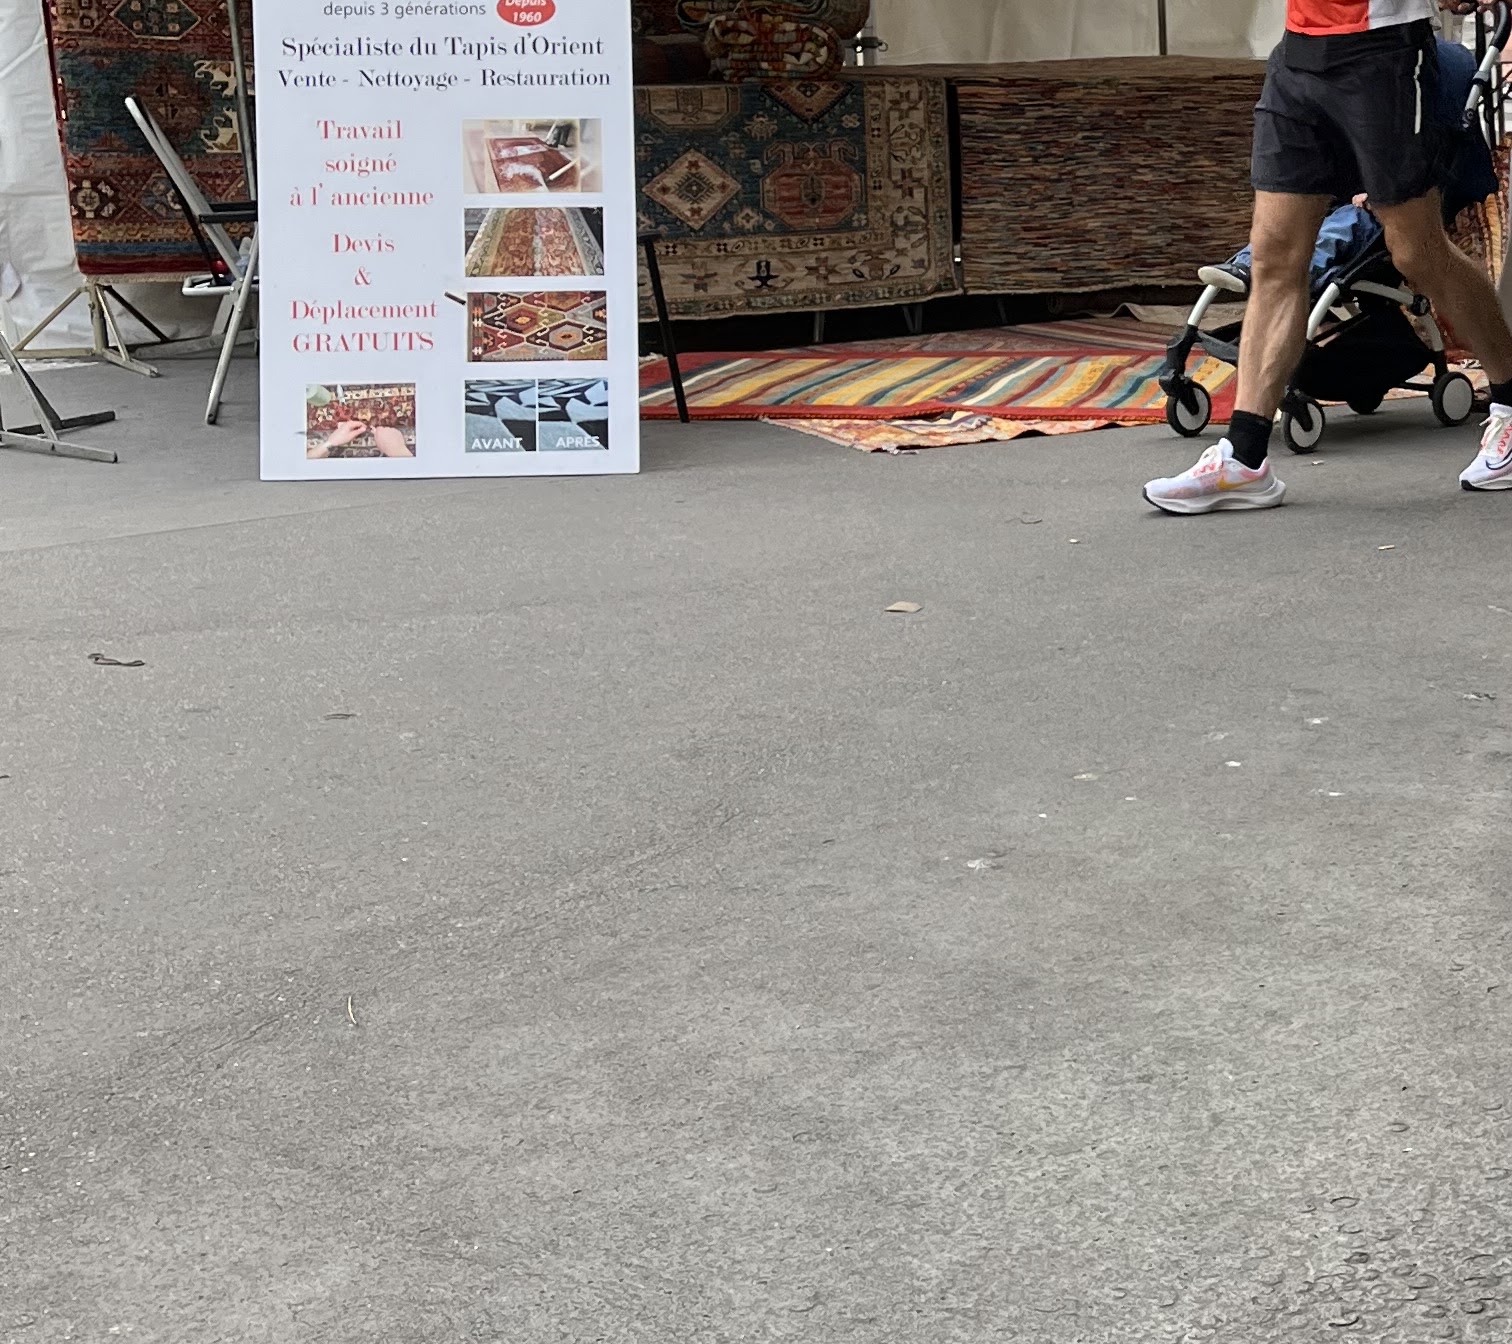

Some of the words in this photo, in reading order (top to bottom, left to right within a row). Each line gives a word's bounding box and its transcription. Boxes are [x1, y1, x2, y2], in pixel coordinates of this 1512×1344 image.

[323, 2, 375, 19] depuis
[380, 3, 389, 16] 3
[395, 2, 487, 19] générations
[512, 11, 542, 24] 1960
[282, 37, 403, 61] Spécialiste
[409, 36, 437, 56] du
[444, 36, 507, 60] Tapis
[513, 32, 605, 56] d'Orient
[278, 69, 337, 88] Vente
[358, 68, 458, 91] Nettoyage
[480, 67, 611, 87] Restauration
[316, 119, 403, 139] Travail
[325, 153, 397, 178] soigné
[290, 187, 302, 206] à
[331, 186, 434, 206] ancienne
[332, 233, 395, 253] Devis
[354, 266, 372, 285] &
[289, 299, 438, 324] Déplacement
[292, 332, 434, 353] GRATUITS
[471, 436, 523, 450] AVANT
